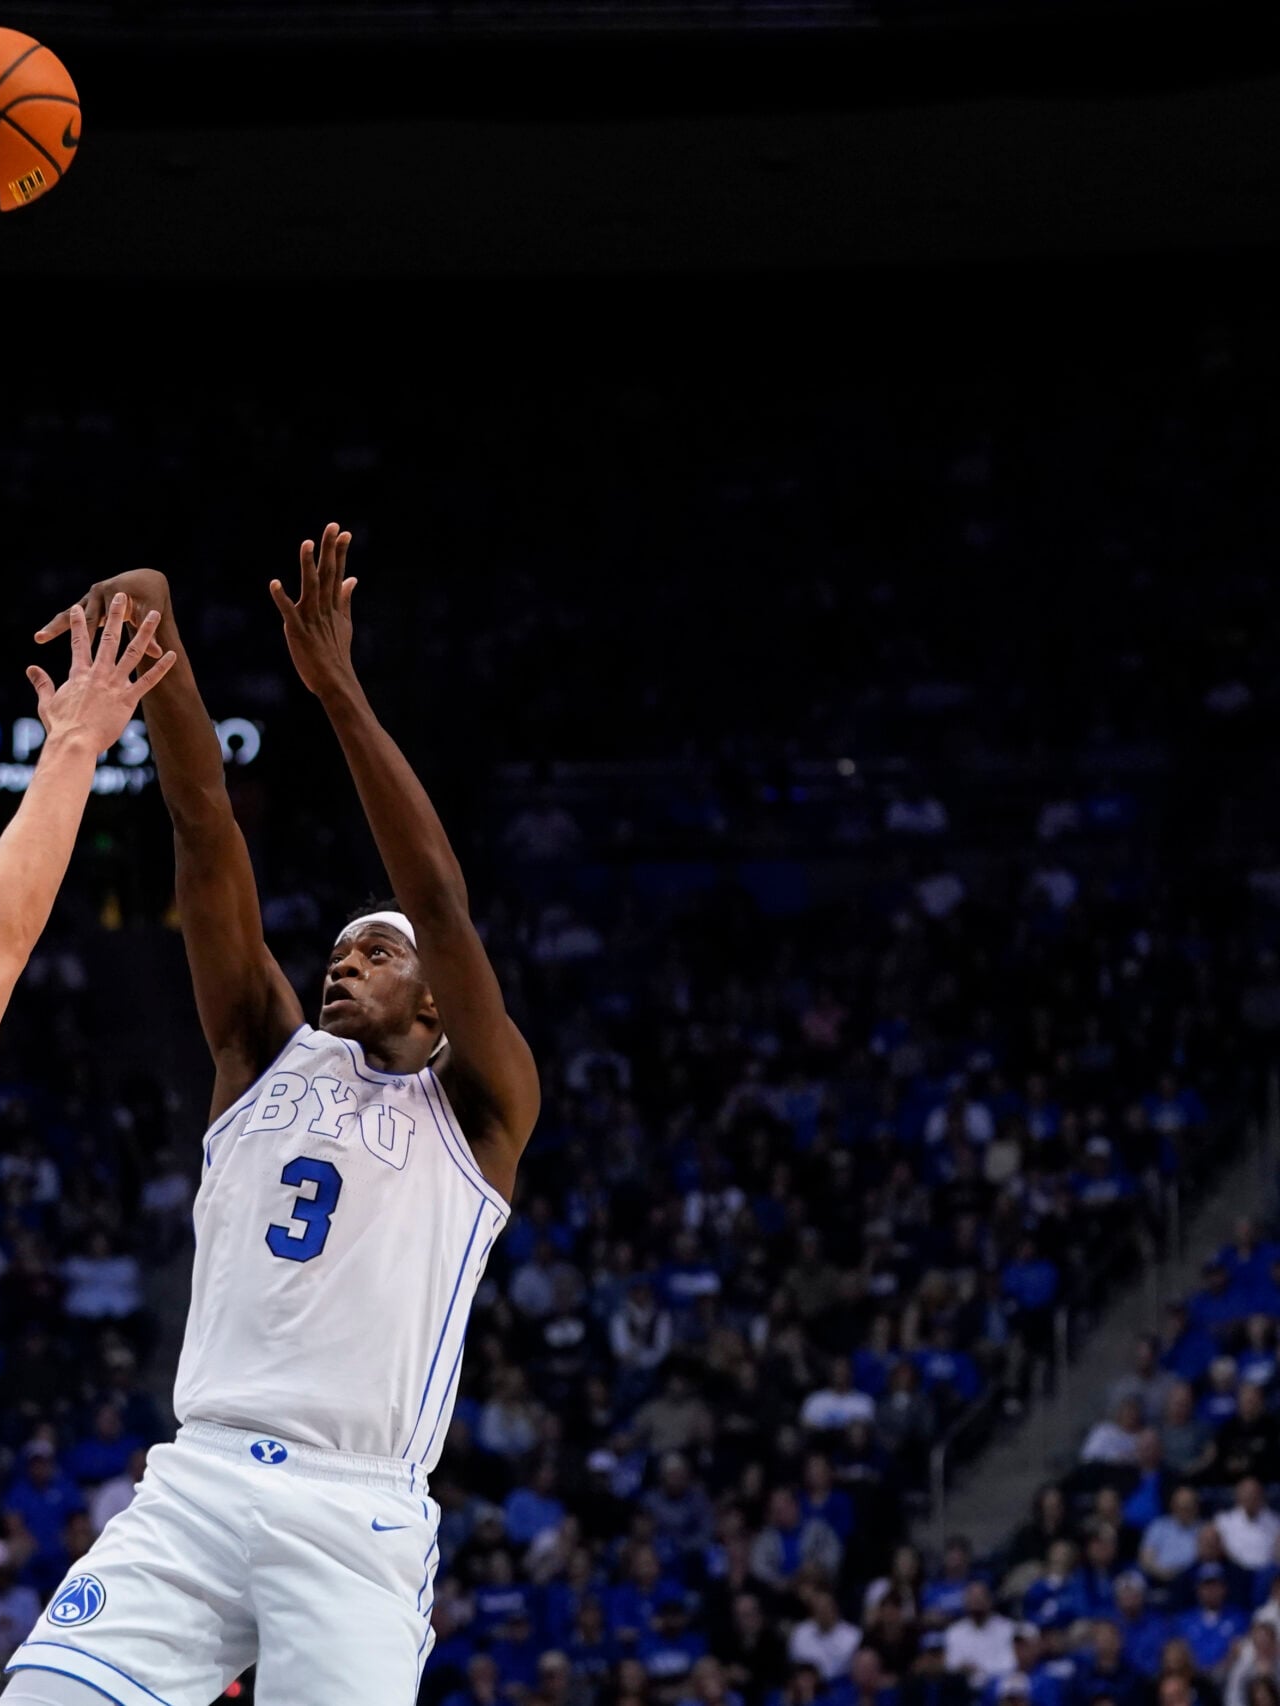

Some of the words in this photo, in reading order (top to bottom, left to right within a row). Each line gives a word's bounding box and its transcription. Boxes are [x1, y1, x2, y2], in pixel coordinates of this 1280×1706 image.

[240, 1071, 416, 1171] BYU
[265, 1156, 343, 1263] 3
[257, 1441, 284, 1463] Y
